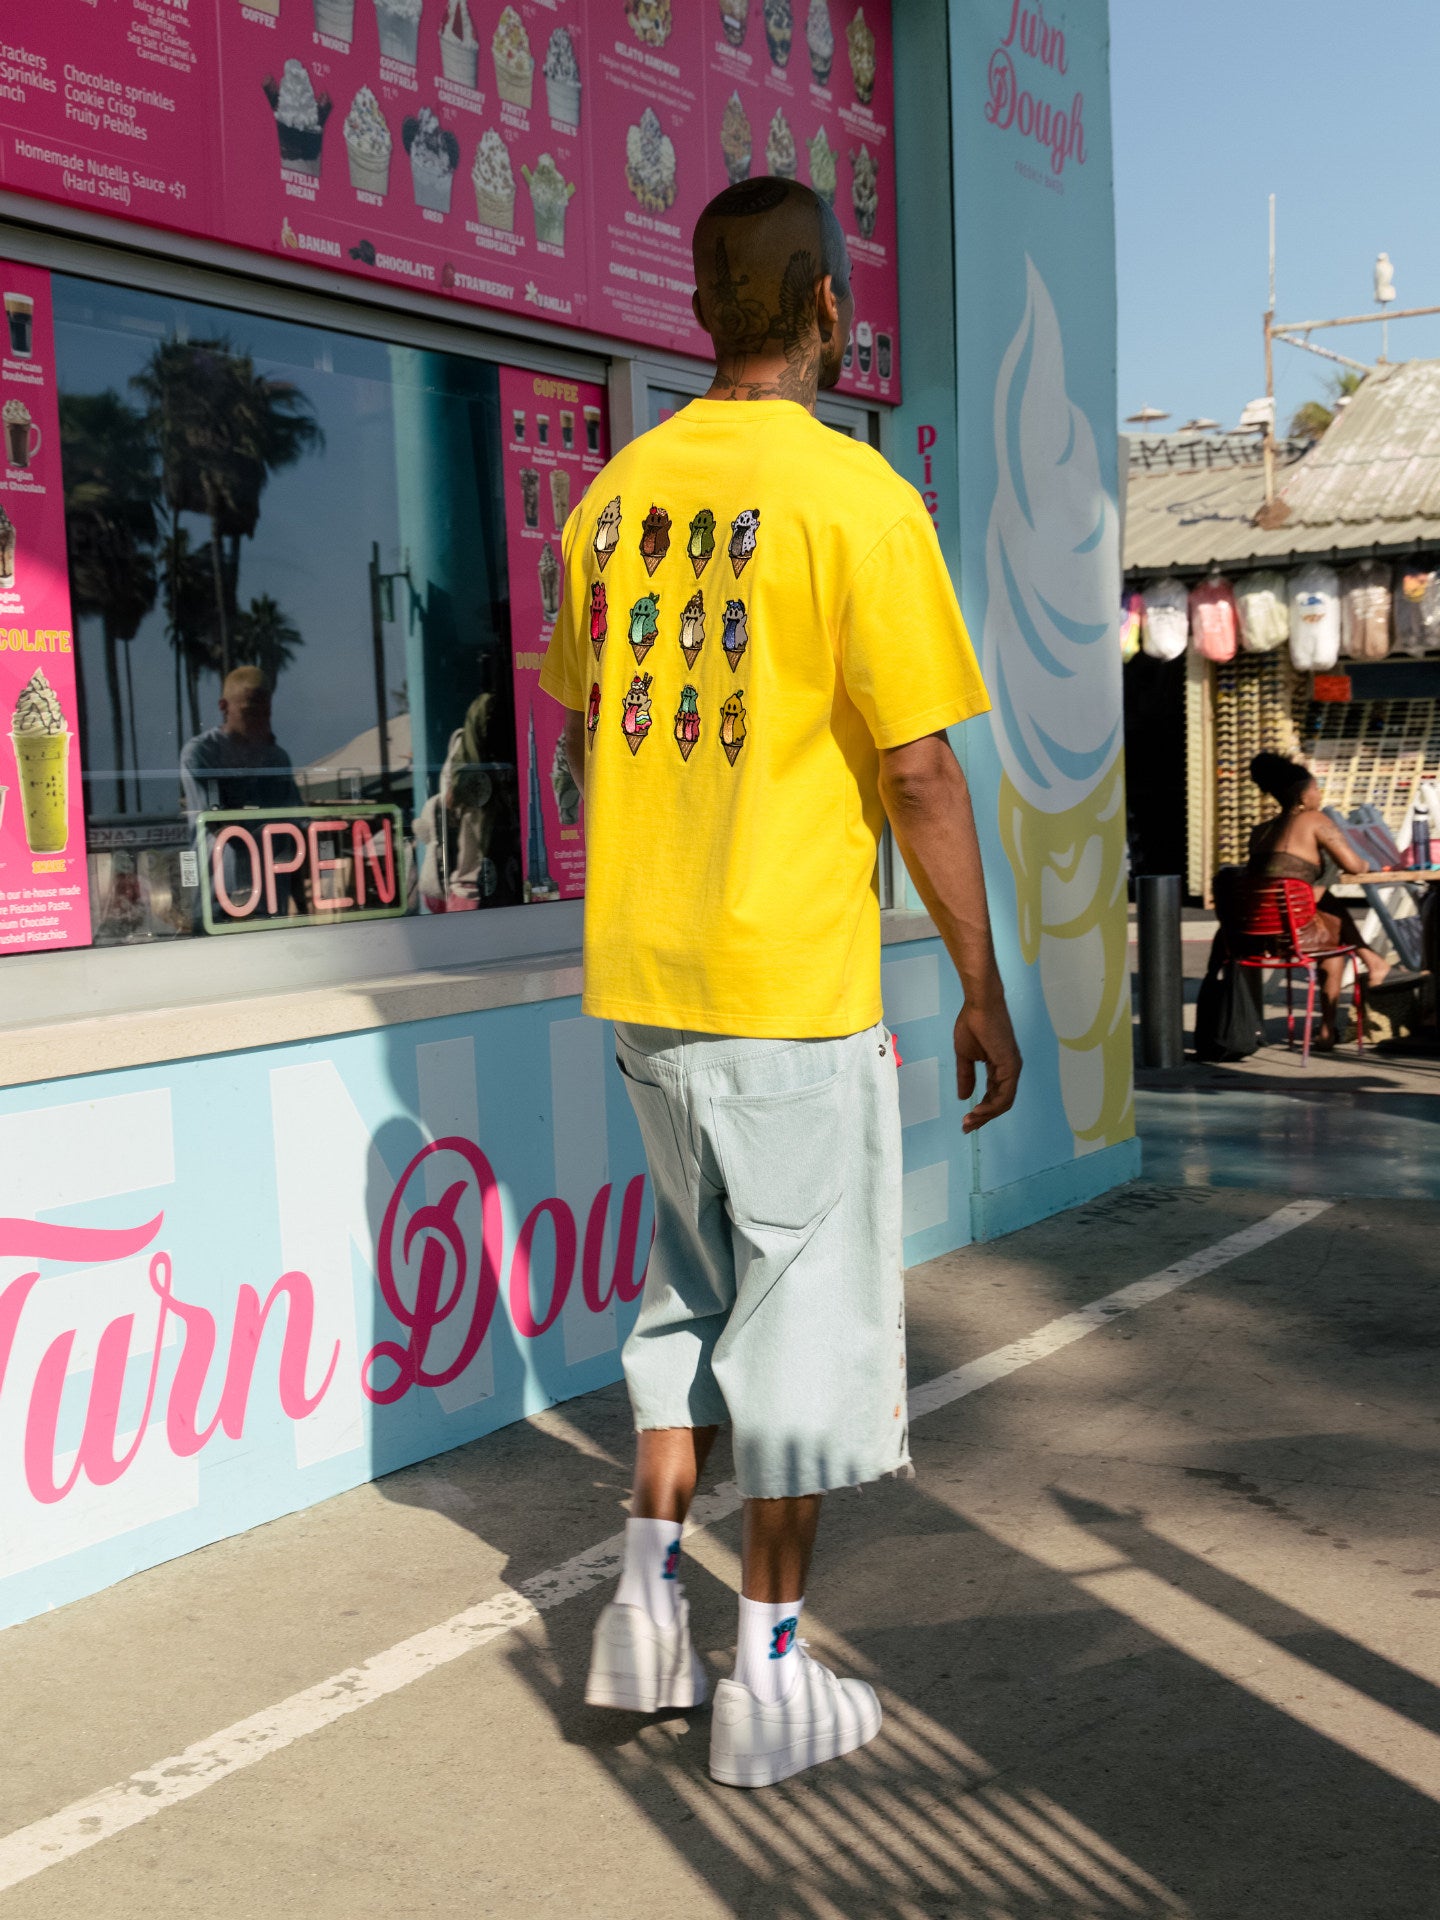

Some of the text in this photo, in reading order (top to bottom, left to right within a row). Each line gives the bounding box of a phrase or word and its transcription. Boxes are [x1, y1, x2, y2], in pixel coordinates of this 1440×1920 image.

[241, 6, 276, 29] COFFEE
[0, 61, 57, 93] Sprinkles
[63, 63, 176, 113] Chocolate sprinkles
[64, 83, 137, 119] Cookie Crisp
[984, 48, 1087, 175] Dough
[65, 103, 148, 140] Fruity Pebbles
[15, 139, 84, 172] Homemade
[87, 158, 130, 184] Nutella
[132, 171, 166, 193] Sauce
[62, 169, 131, 206] (Hard Shell)
[280, 169, 319, 190] NUTELLA
[285, 183, 315, 202] DREAM
[297, 233, 341, 258] BANANA
[375, 254, 435, 280] CHOCOLATE
[453, 272, 514, 300] STRAWBERRY
[537, 294, 572, 314] VANILLA
[532, 378, 578, 403] COFFEE
[213, 817, 397, 917] OPEN
[9, 902, 46, 914] Pistachio
[47, 901, 72, 912] Paste,
[19, 916, 60, 928] Chocolate
[26, 929, 68, 942] Pistachios
